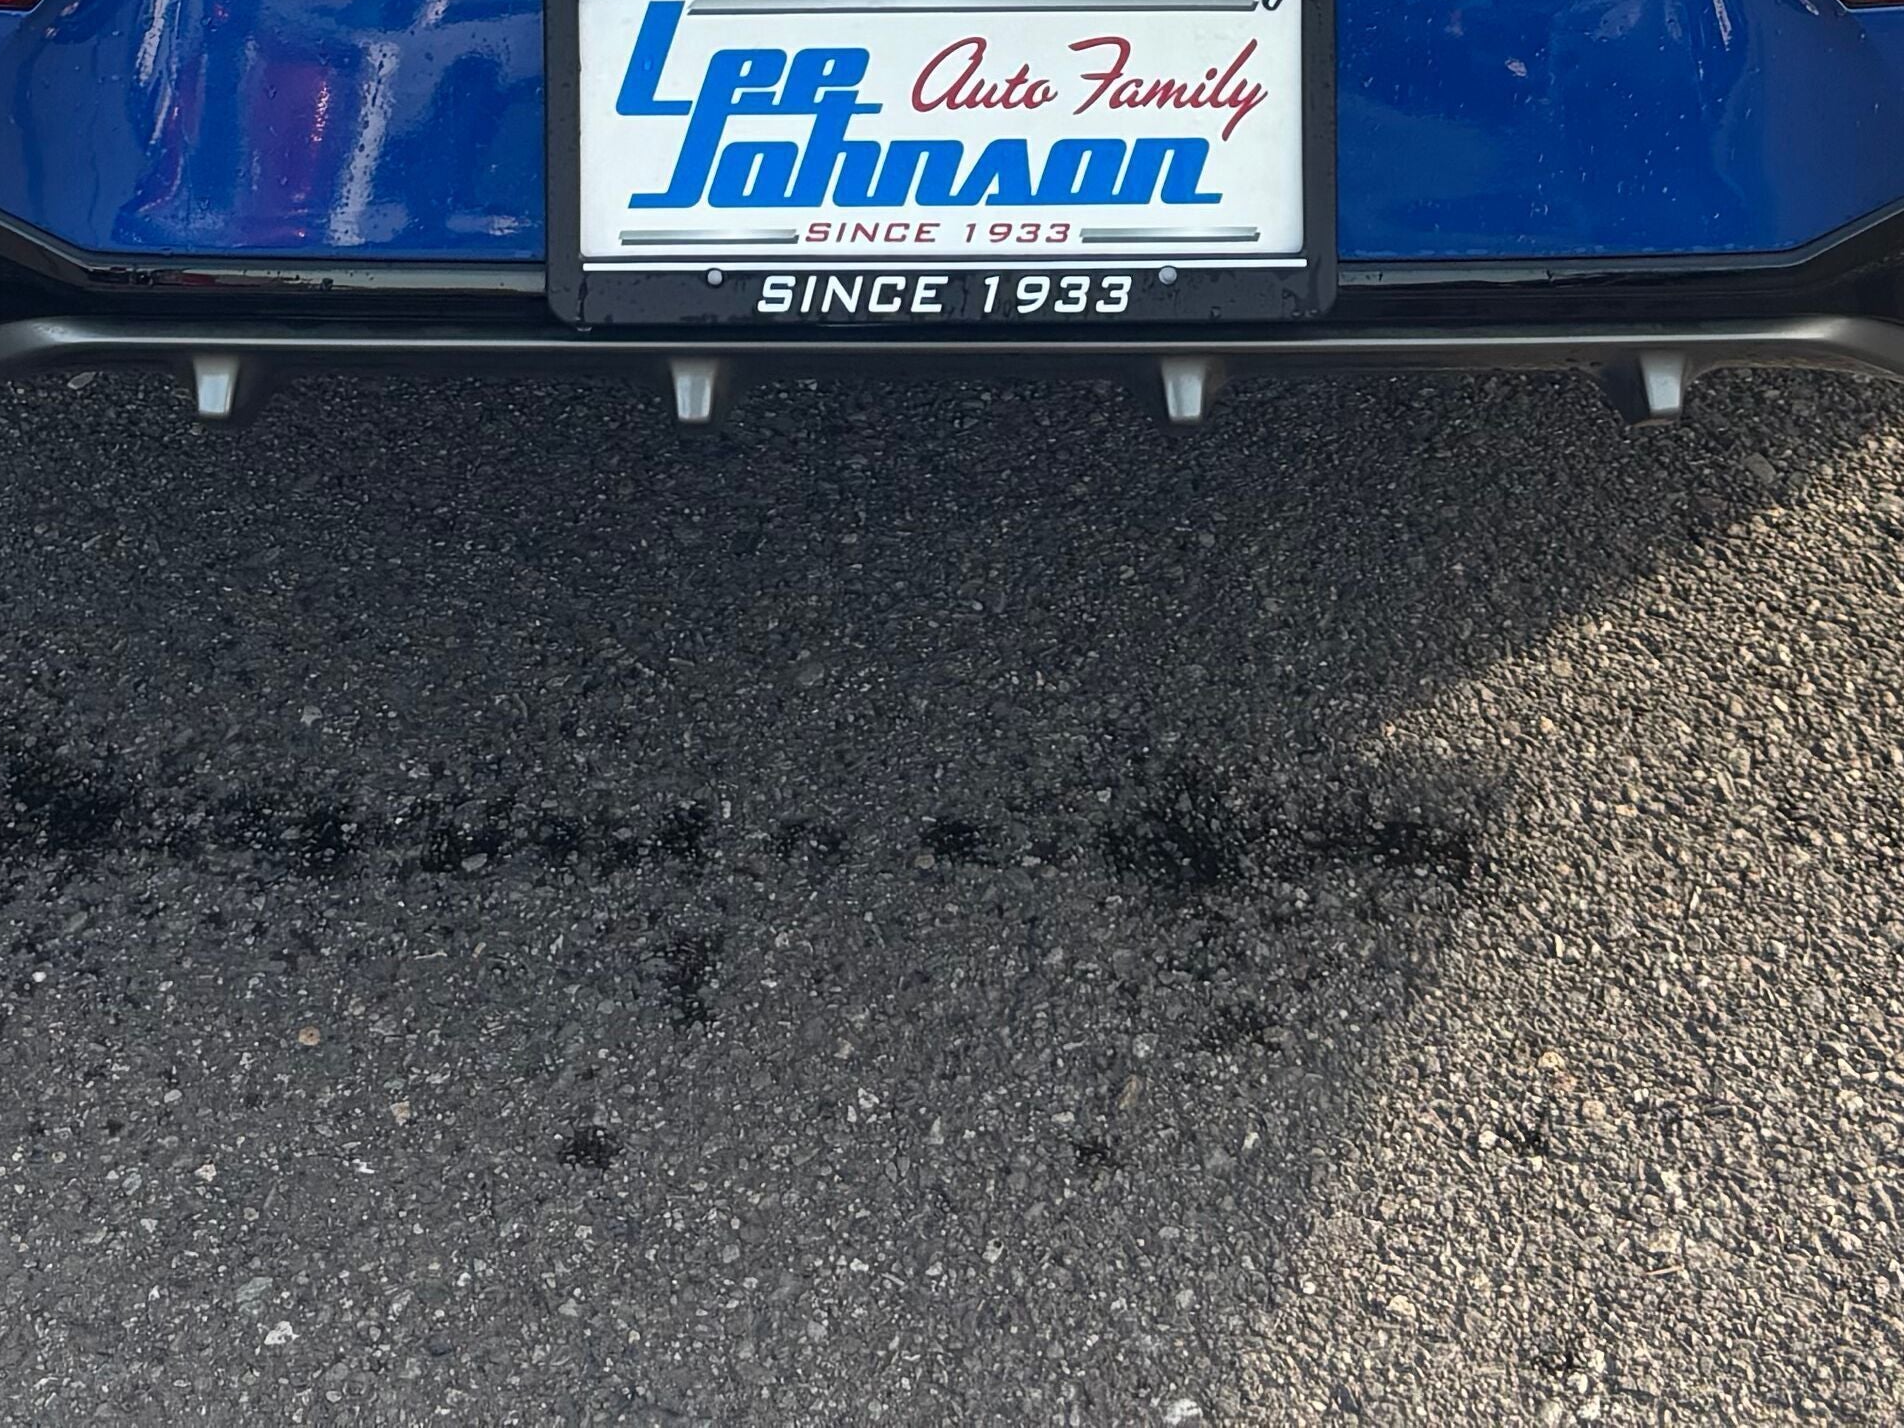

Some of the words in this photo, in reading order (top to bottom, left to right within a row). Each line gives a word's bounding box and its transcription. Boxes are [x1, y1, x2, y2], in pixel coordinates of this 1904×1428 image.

[616, 1, 882, 116] Lee
[911, 36, 1058, 113] Auto
[1068, 36, 1268, 141] Family
[628, 105, 1222, 209] Johnson
[805, 222, 941, 244] SINCE
[964, 222, 1072, 244] 1933
[756, 275, 948, 314] SINCE
[982, 275, 1133, 314] 1933
